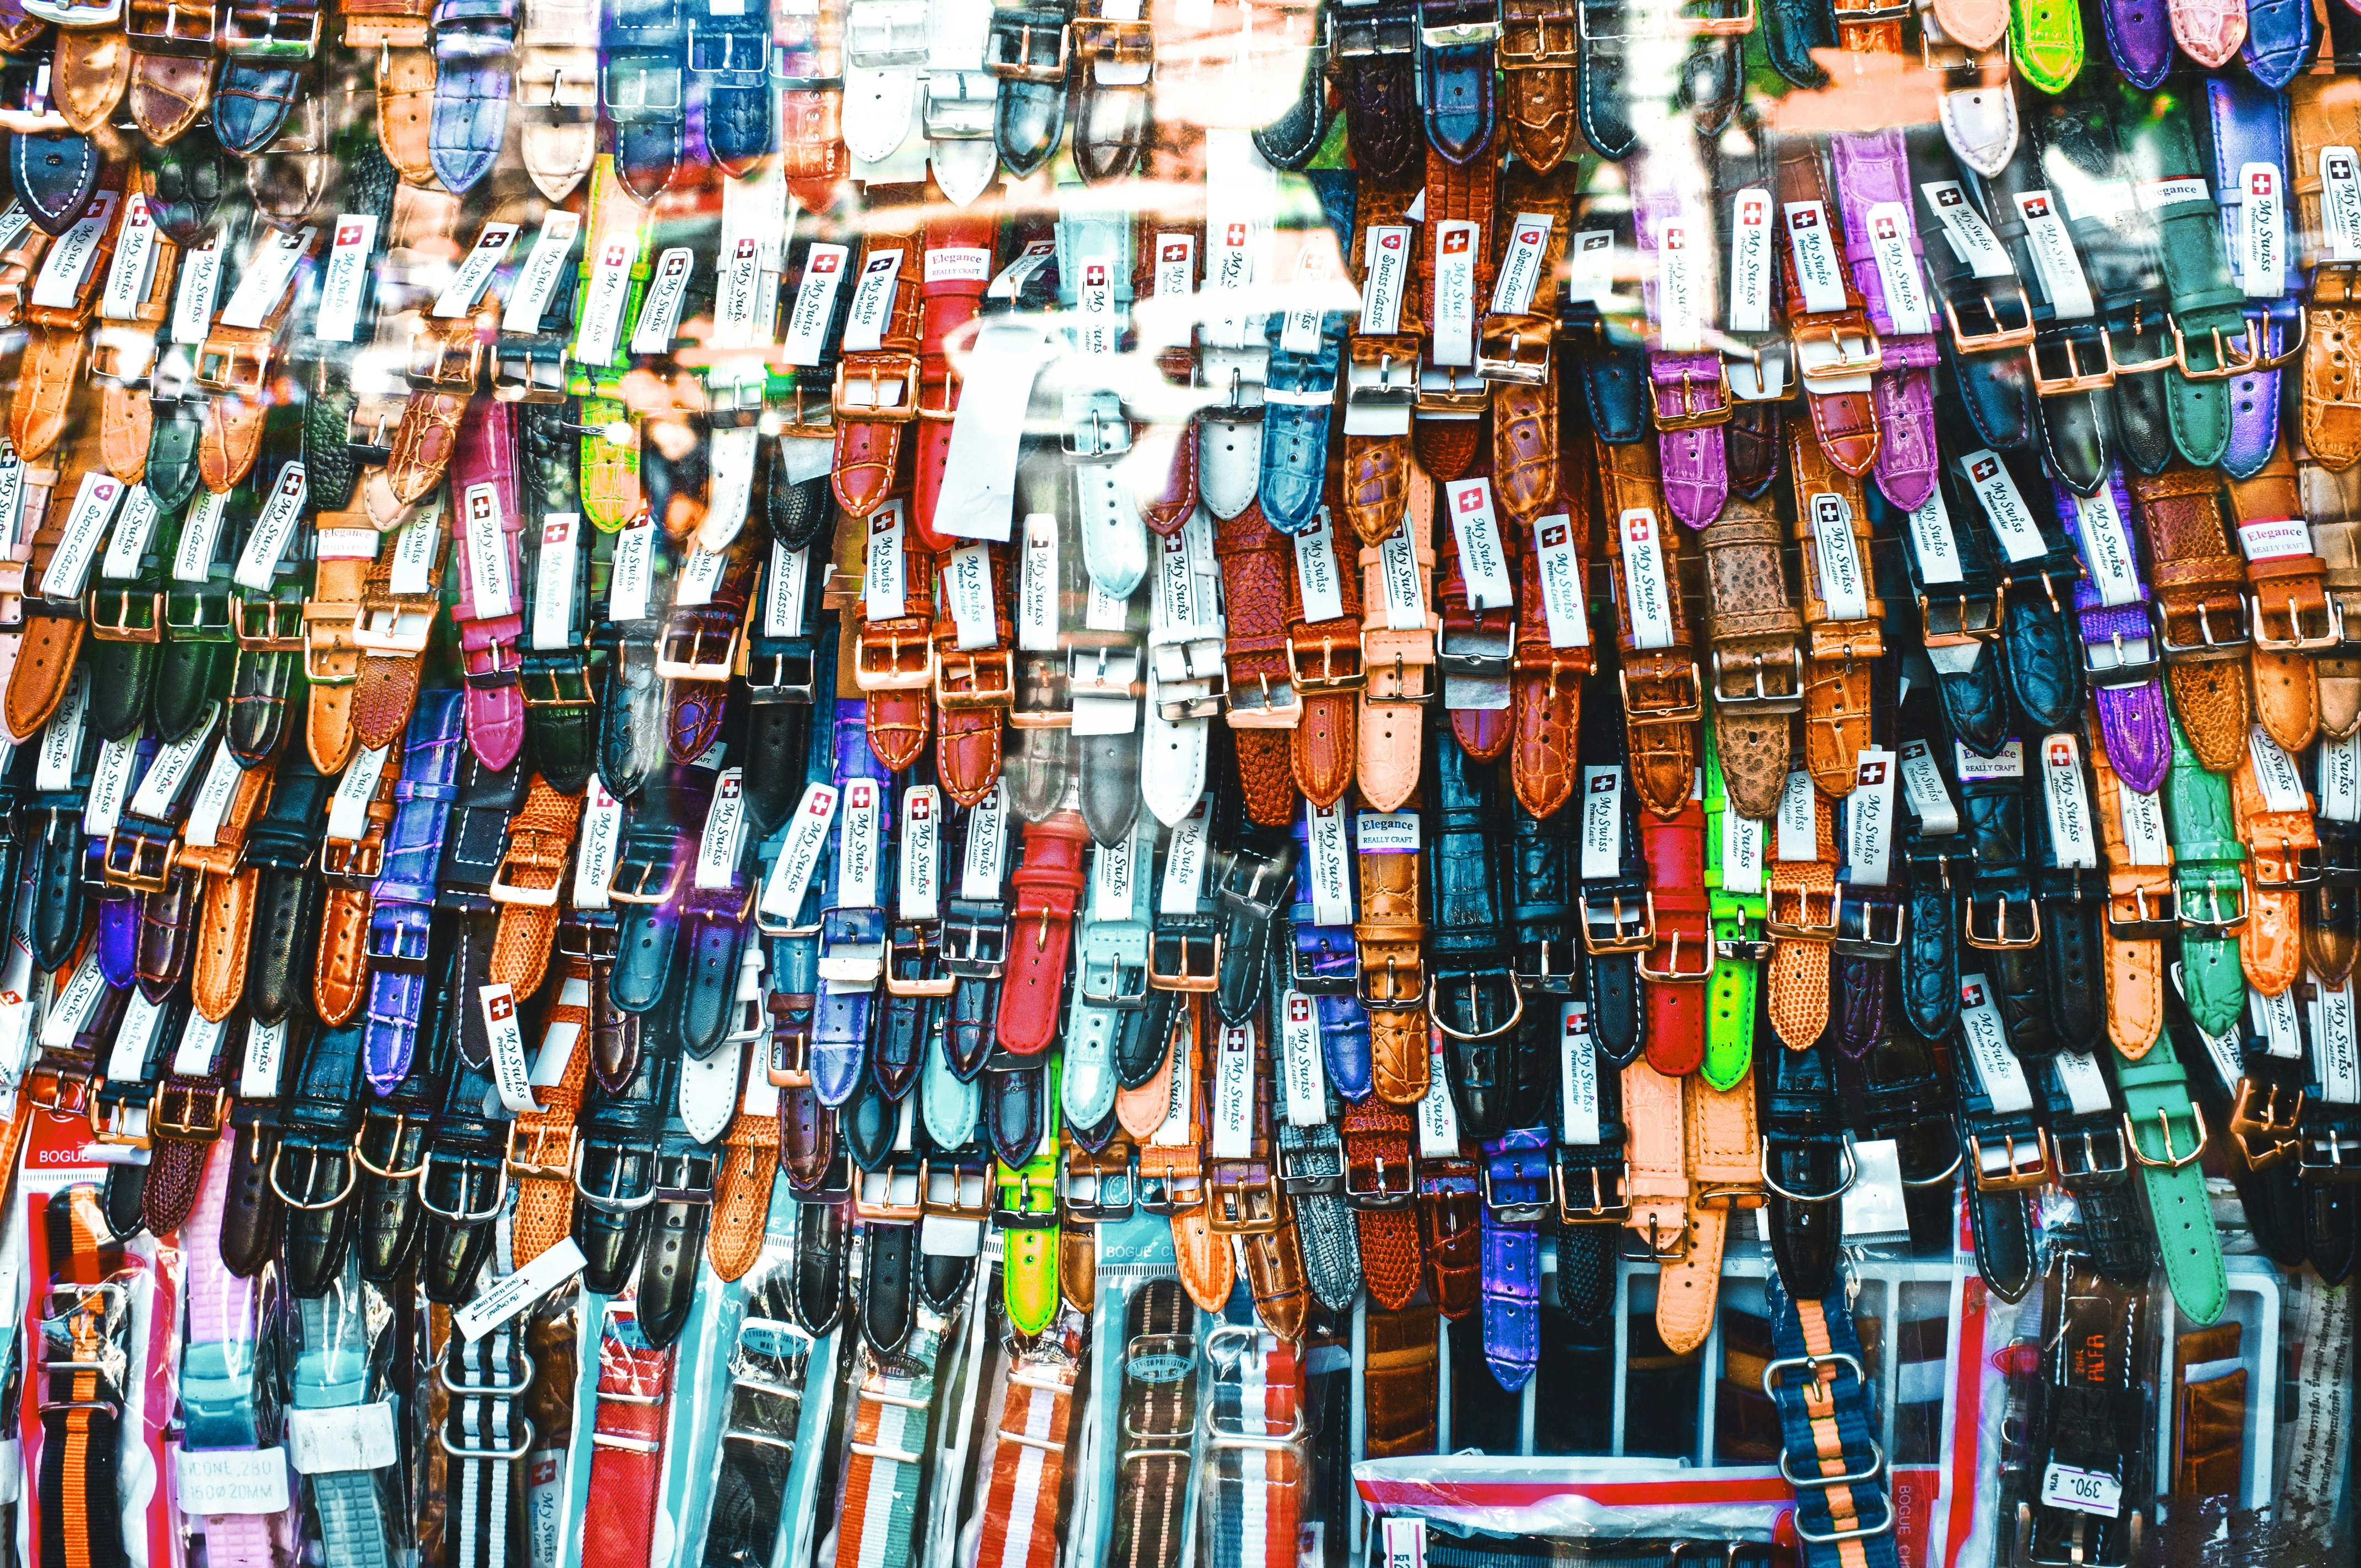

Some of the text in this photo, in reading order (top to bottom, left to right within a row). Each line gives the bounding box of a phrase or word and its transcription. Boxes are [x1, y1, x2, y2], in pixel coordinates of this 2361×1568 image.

[60, 224, 94, 278] My Swiss
[119, 233, 144, 300] My Swiss
[932, 254, 982, 265] Elegance
[1745, 230, 1761, 306] My Swiss
[2255, 200, 2276, 273] My Swiss
[651, 278, 678, 333] My Swiss
[802, 279, 826, 337] My Swiss
[862, 276, 884, 325] My Swiss
[1372, 254, 1395, 328] Swiss classic
[1450, 263, 1466, 334] My Swiss
[1503, 248, 1532, 313] Swiss classic
[1889, 243, 1917, 312] My Swiss
[254, 499, 293, 566] My Swiss
[324, 529, 371, 540] Elegance
[411, 513, 431, 564] My Swiss
[1991, 482, 2025, 533] My Swiss
[2247, 529, 2302, 542] Elegance
[53, 505, 101, 590] Swiss classic
[186, 525, 204, 570] classic
[478, 523, 501, 595] My Swiss
[878, 537, 893, 594] My Swiss
[1307, 540, 1326, 594] My Swiss
[1473, 518, 1493, 578] My Swiss
[1830, 527, 1855, 595] My Swiss
[2253, 545, 2280, 553] REALLY
[775, 549, 795, 626] wiss classic
[962, 555, 985, 623] My Swiss
[1032, 553, 1048, 627] My Swiss
[1169, 556, 1189, 620] My Swiss
[1553, 553, 1577, 620] My Swiss
[1638, 545, 1661, 621] My Swiss
[101, 743, 127, 814] My Swiss
[591, 813, 611, 886] My Swiss
[712, 803, 735, 867] My Swiss
[788, 821, 823, 894] My Swiss
[854, 814, 869, 884] My Swiss
[980, 814, 996, 877] My Swiss
[1179, 825, 1200, 885] My Swiss
[1362, 819, 1413, 831] Elegance
[1595, 797, 1613, 853] My Swiss
[1863, 796, 1880, 865] My Swiss
[1322, 823, 1342, 900] My Swiss
[501, 1027, 528, 1099] My Swiss
[1295, 1028, 1315, 1100] My Swiss
[1577, 1043, 1595, 1114] My Swiss
[1978, 1012, 2012, 1080] My Swiss
[1229, 1057, 1244, 1133] My Swiss
[1106, 1246, 1152, 1257] BOGUE
[474, 1277, 519, 1311] Swiss Watch Straps
[487, 1293, 520, 1320] The Original
[2087, 1335, 2104, 1381] ALFA
[539, 1491, 557, 1563] My Swiss
[1897, 1485, 1911, 1534] BOGUE
